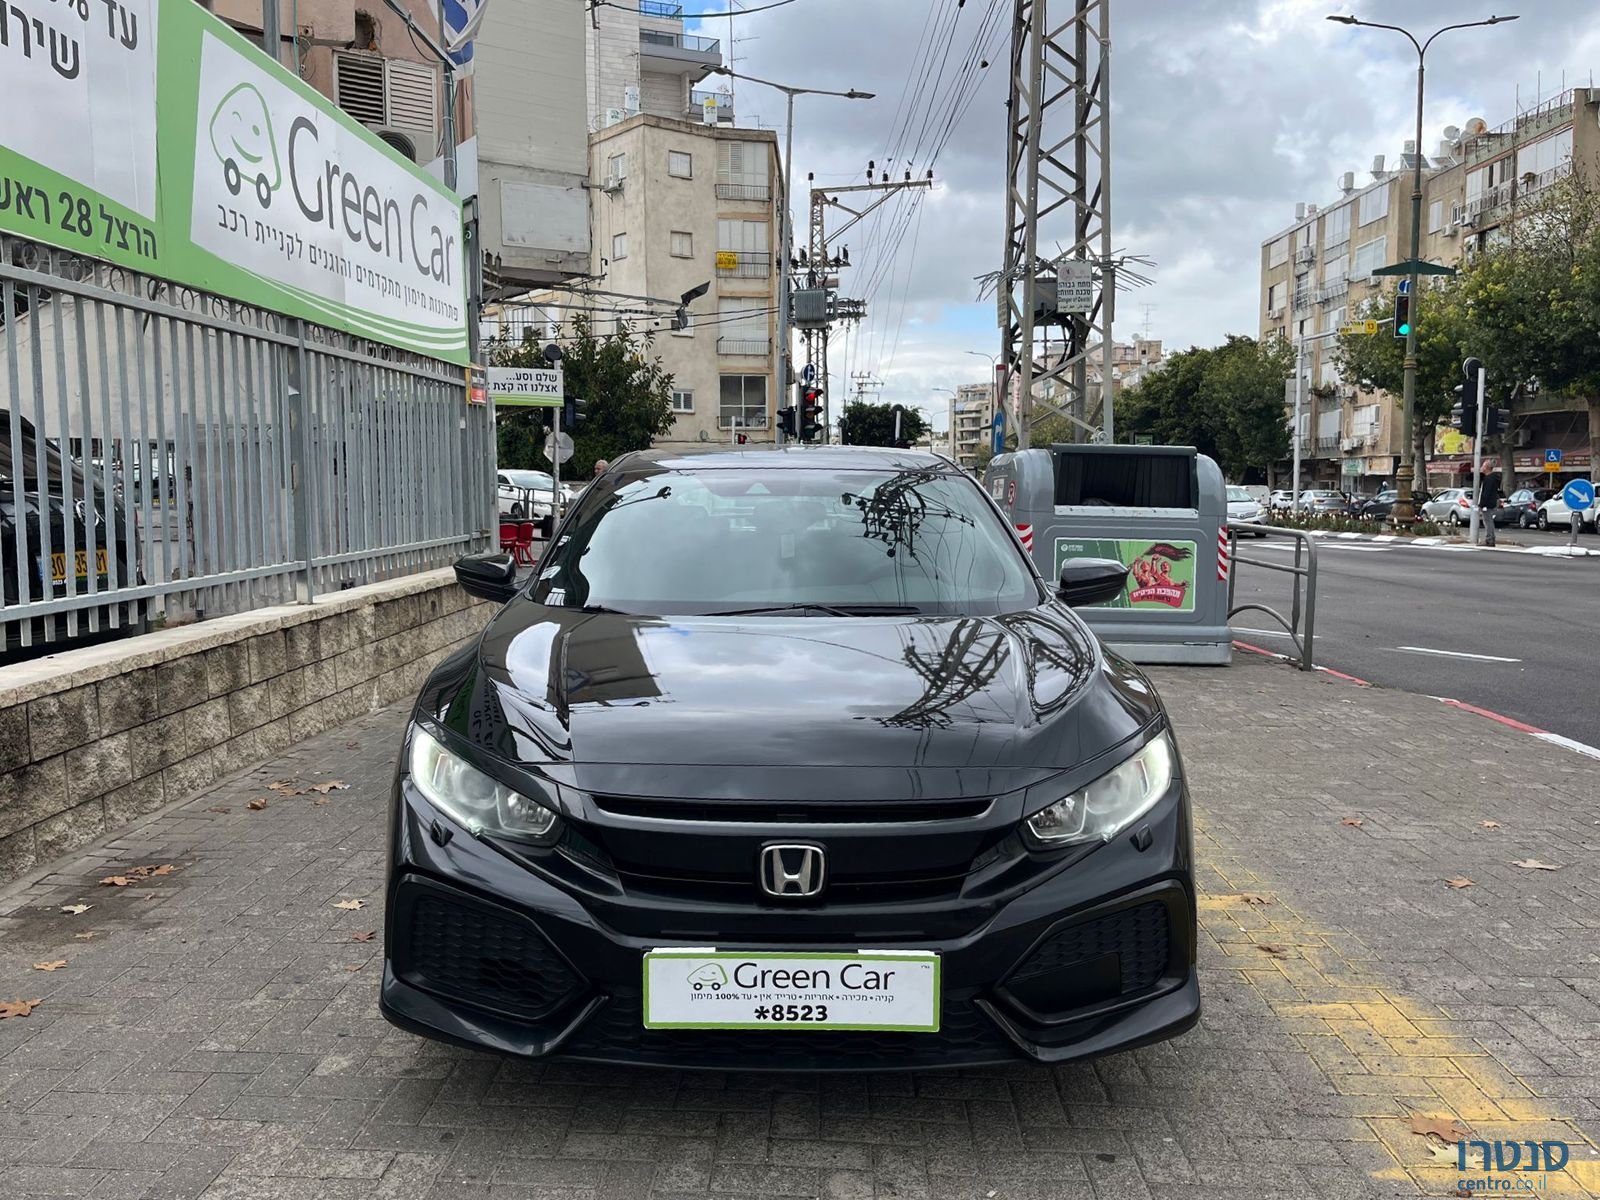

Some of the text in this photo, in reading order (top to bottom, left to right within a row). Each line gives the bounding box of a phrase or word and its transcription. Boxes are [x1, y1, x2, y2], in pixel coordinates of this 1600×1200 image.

[288, 116, 454, 286] Green Car
[58, 191, 93, 237] 28
[99, 203, 158, 260] הרצל
[217, 204, 458, 322] פתרונות מימון מתקדמים והוגנים לקניית רכב
[536, 372, 557, 382] שלם
[493, 382, 514, 393] קצת
[517, 383, 528, 391] זה
[531, 382, 558, 392] אצלנו
[734, 962, 895, 990] Green Car
[690, 993, 713, 1002] מימון
[760, 993, 772, 1002] אין
[775, 993, 797, 1001] טרייד
[804, 993, 834, 1001] אחריות
[841, 993, 867, 1001] מכירה
[874, 994, 894, 1003] קניה
